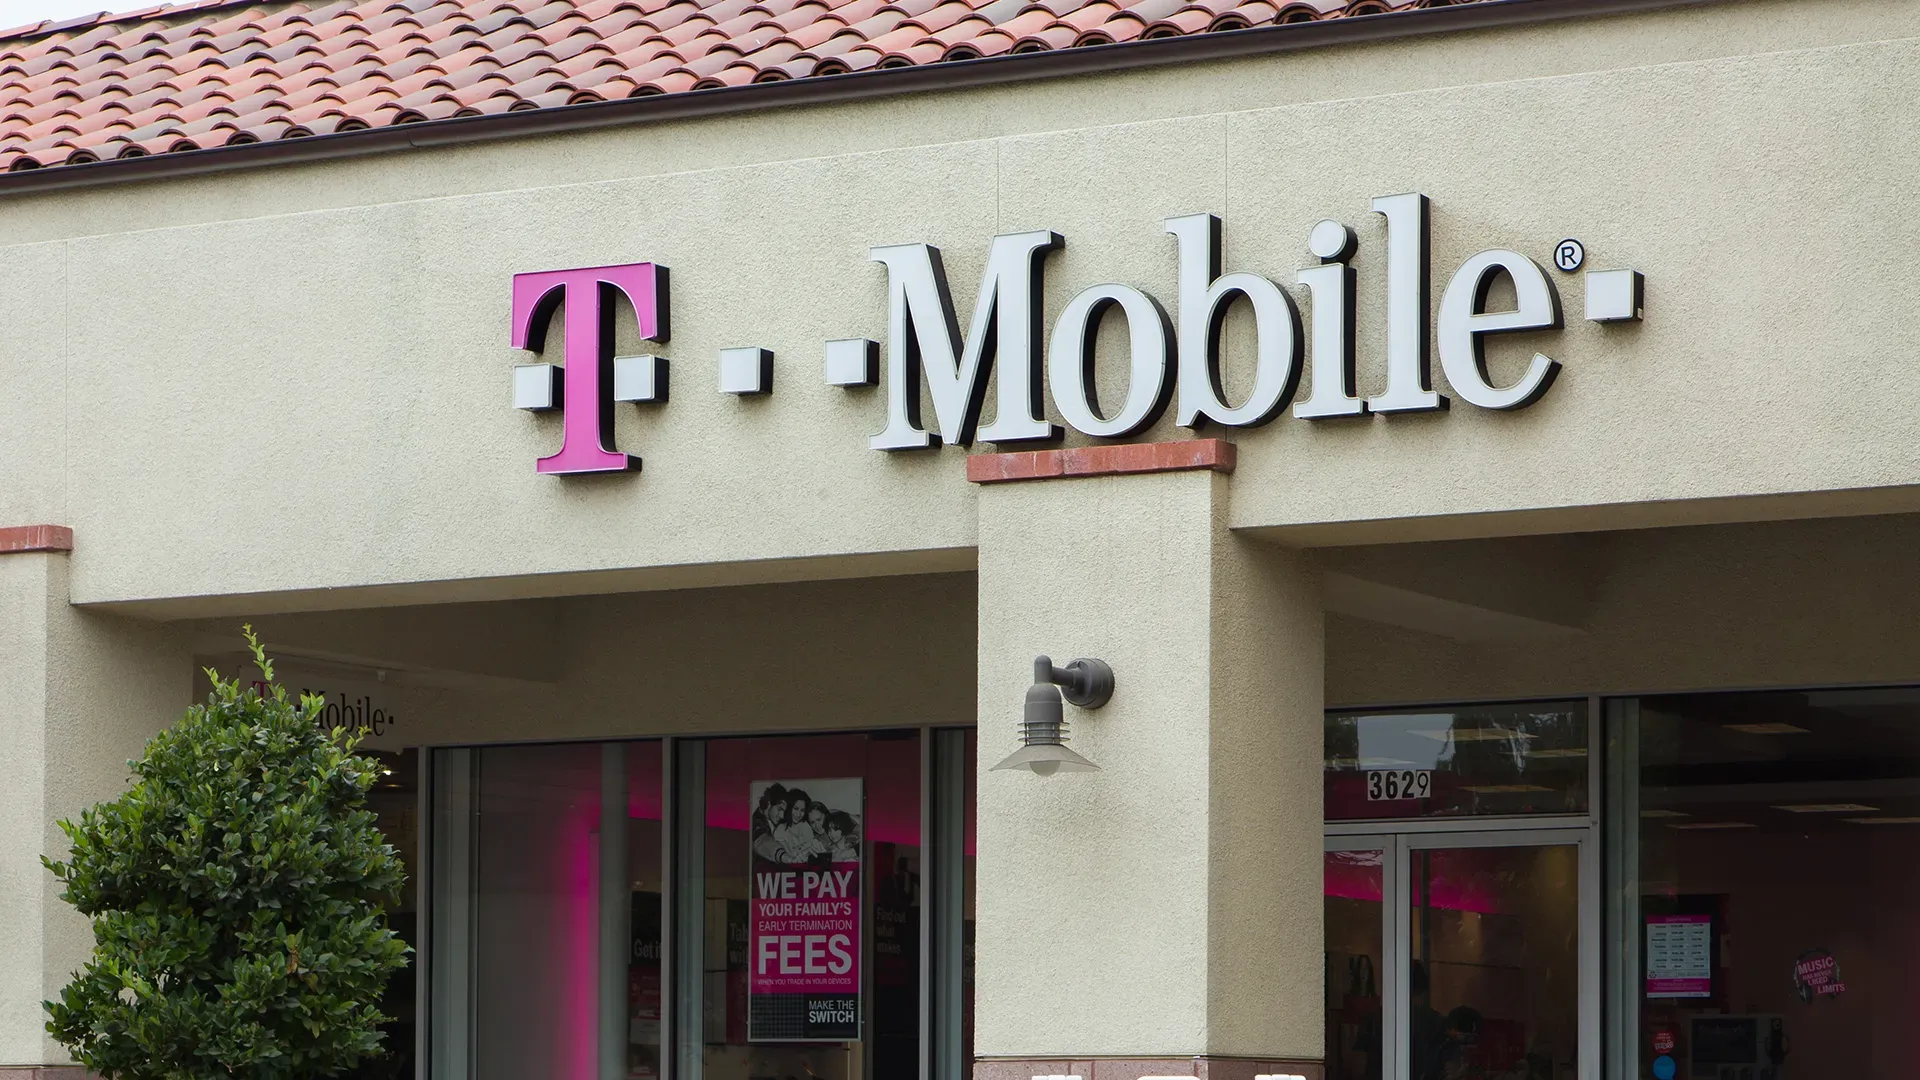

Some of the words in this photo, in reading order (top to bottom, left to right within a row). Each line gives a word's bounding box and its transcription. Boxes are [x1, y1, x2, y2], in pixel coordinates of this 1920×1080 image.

[1369, 771, 1429, 799] 3629
[757, 872, 797, 899] WE
[803, 870, 854, 898] PAY
[759, 903, 793, 916] YOUR
[795, 902, 852, 916] FAMILY'S
[758, 920, 787, 931] EARLY
[789, 919, 853, 931] TERMINATION
[758, 934, 852, 975] FEES
[1797, 956, 1834, 975] MUSIC
[1807, 976, 1829, 986] LIKED
[1817, 983, 1846, 994] LIMITS
[808, 1000, 834, 1010] MAKE
[836, 1000, 854, 1010] THE
[808, 1011, 854, 1023] SWITCH
